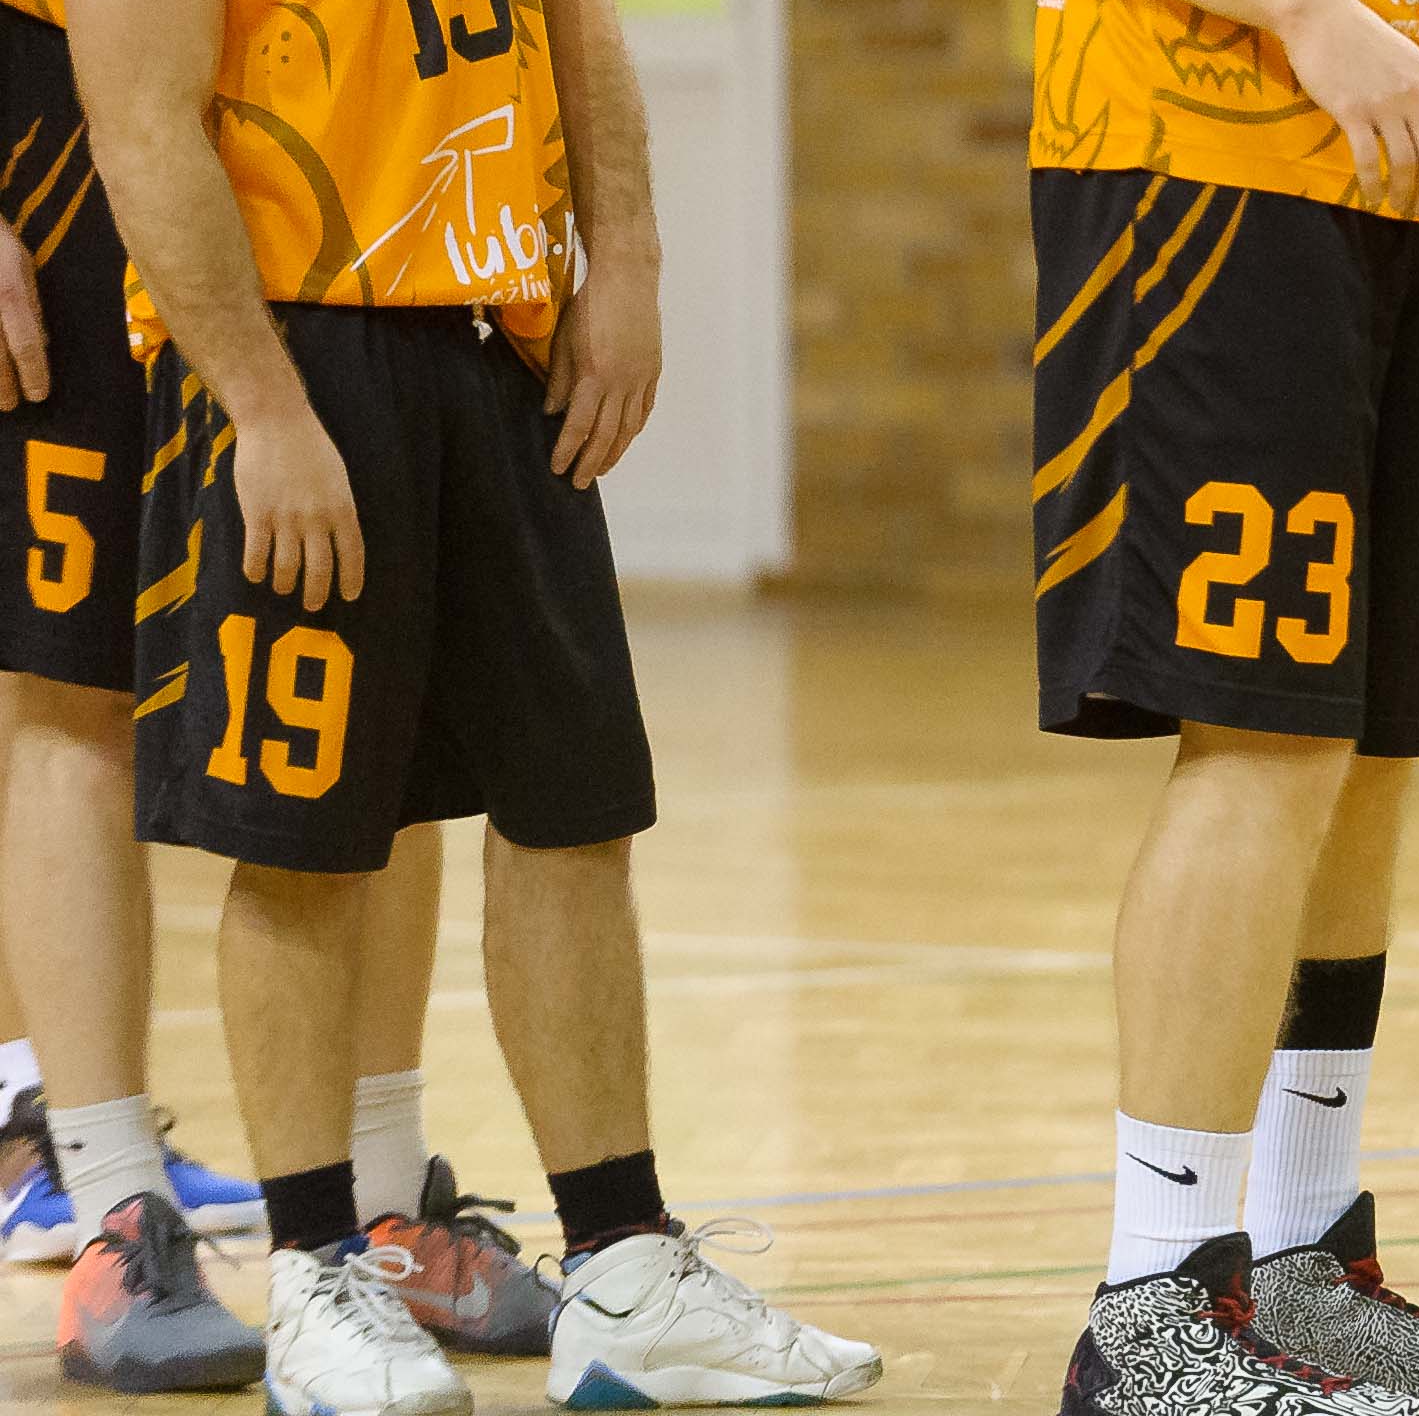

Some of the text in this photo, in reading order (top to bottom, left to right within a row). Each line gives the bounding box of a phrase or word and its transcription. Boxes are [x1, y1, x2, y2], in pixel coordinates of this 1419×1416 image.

[26, 439, 107, 614] 5
[1175, 481, 1356, 664] 23
[206, 615, 355, 799] 19
